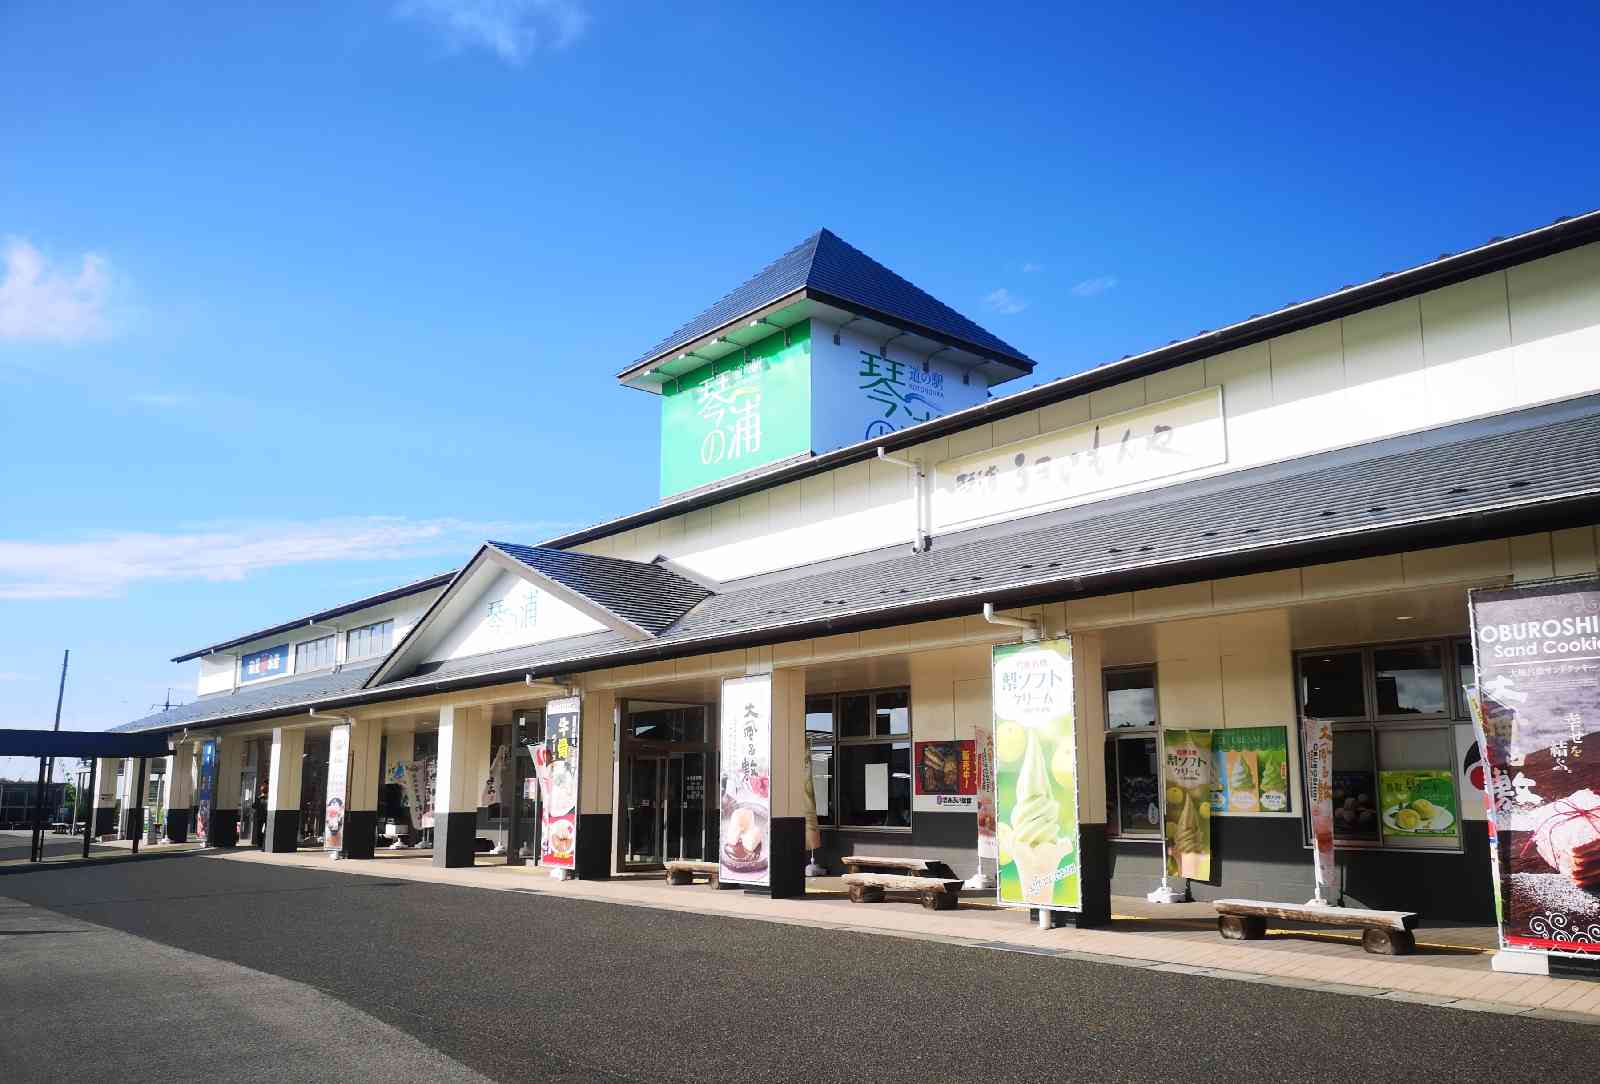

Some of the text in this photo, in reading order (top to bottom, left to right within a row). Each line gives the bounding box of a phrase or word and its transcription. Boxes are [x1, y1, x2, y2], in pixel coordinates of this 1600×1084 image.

[909, 365, 944, 387] 道の駅
[1480, 616, 1599, 643] OBUROSHI
[1494, 642, 1537, 658] Sand
[1001, 669, 1063, 691] 梨ソフト
[1014, 692, 1054, 705] クリーム
[1566, 712, 1585, 758] 幸せを
[1167, 754, 1207, 767] 梨ソフト
[1175, 767, 1200, 776] クリーム
